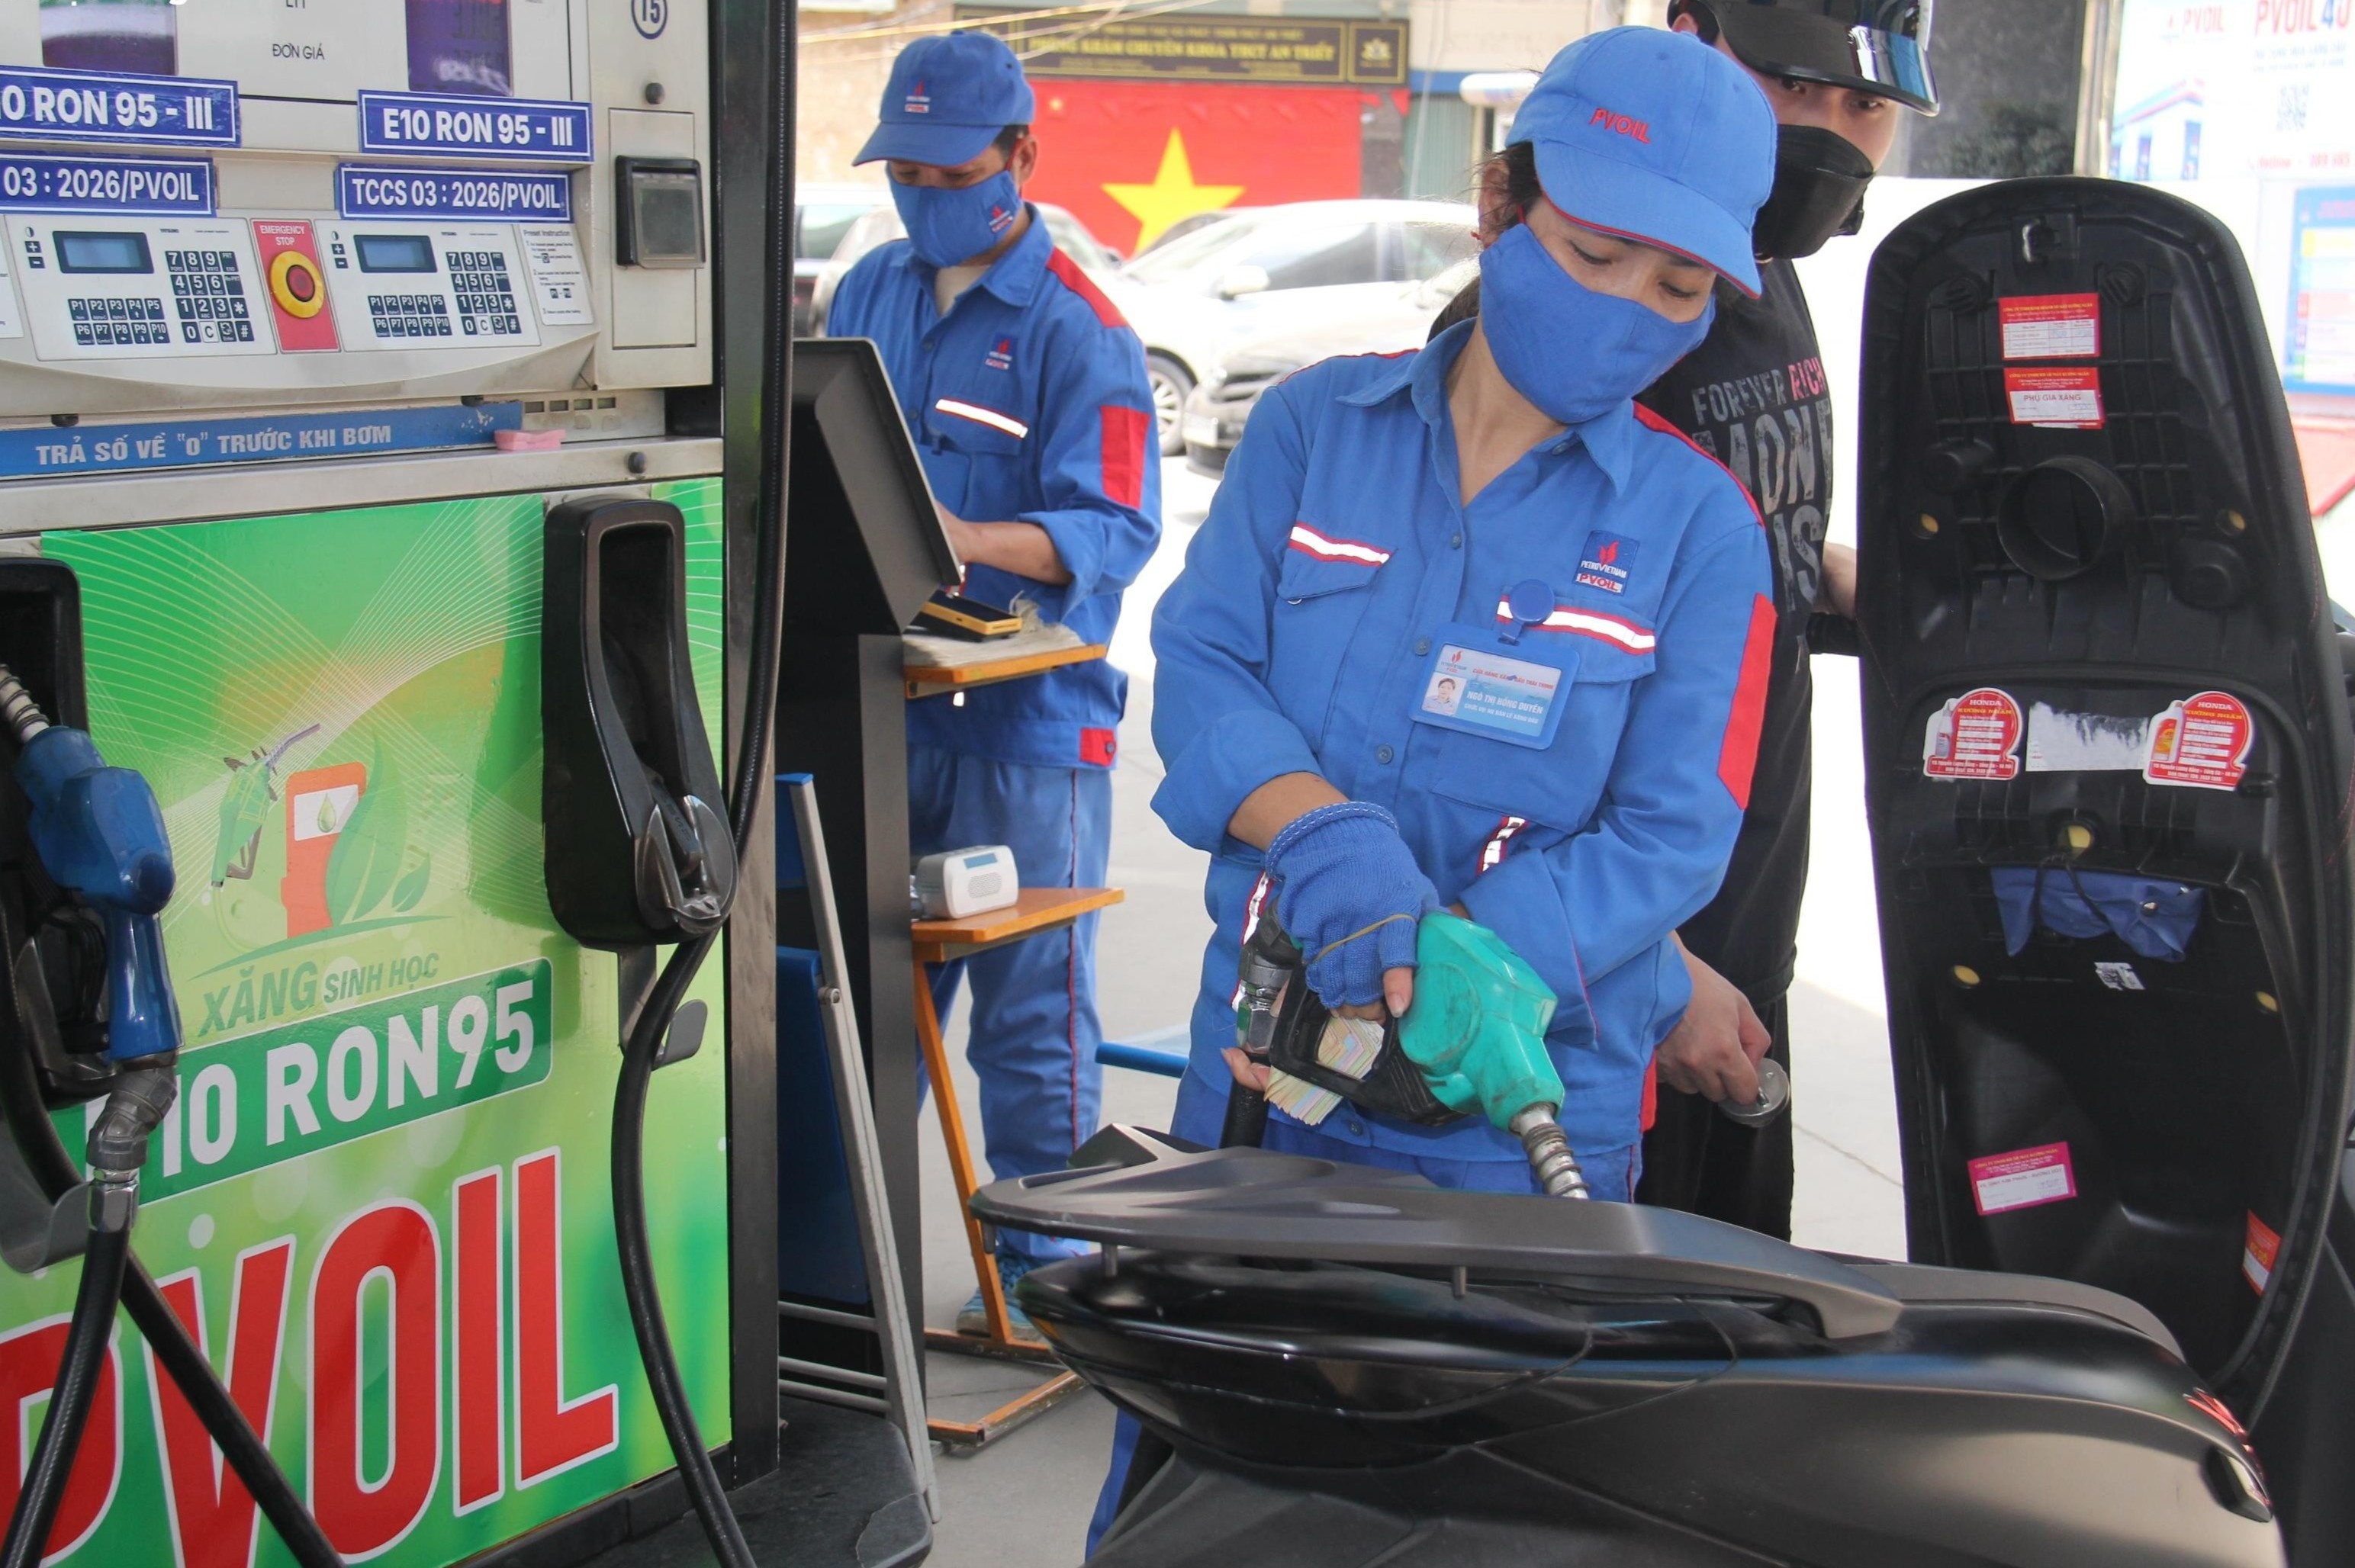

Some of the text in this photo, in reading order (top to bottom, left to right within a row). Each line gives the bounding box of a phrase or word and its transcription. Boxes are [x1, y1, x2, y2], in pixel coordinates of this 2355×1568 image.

[642, 0, 660, 24] 15
[2183, 6, 2224, 33] PVOIL
[2254, 0, 2317, 37] PVOIL
[272, 43, 325, 60] ĐƠN GIÁ
[34, 87, 108, 125] RON
[115, 92, 158, 127] 95
[185, 96, 213, 130] III
[382, 108, 430, 141] E10
[436, 111, 493, 143] RON
[497, 114, 530, 145] 95
[551, 117, 572, 146] III
[1589, 107, 1651, 144] PVOIL
[4, 166, 37, 197] 03
[57, 169, 199, 203] 2026/PVOIL
[352, 178, 407, 206] TCCS
[411, 180, 437, 207] 03
[452, 181, 561, 211] 2026/PVOIL
[259, 225, 305, 235] EMERGENCY
[275, 236, 295, 246] STOP
[168, 252, 215, 266] 7 8 9
[447, 253, 488, 265] 7 8 9
[175, 275, 220, 289] 4 5 6
[455, 275, 493, 286] 4 5 6
[71, 300, 159, 311] P1 P2 P3 P4 P5
[180, 299, 227, 313] 1 2 3
[370, 297, 443, 306] P1 P2 P3 P4 P5
[460, 296, 497, 307] 1 2 3
[77, 324, 166, 335] P6 P7 P8 P9 P10
[376, 318, 449, 328] P6 P7 P8 P9 P10
[187, 326, 249, 339] 0 C #
[1691, 356, 1826, 426] FOREVER RICH
[36, 435, 86, 466] TRẢ
[94, 436, 128, 462] SỐ
[137, 432, 166, 459] VỀ
[218, 427, 291, 455] TRƯỚC
[299, 428, 335, 449] KHI
[343, 425, 391, 446] BƠM
[1581, 560, 1627, 579] PETROVIETNAM
[1578, 573, 1620, 592] PVOIL
[1484, 695, 1495, 706] THỊ
[2198, 702, 2233, 711] HONDA
[198, 953, 439, 1037] XĂNG SINH HỌC
[0, 1145, 619, 1568] PVOIL
